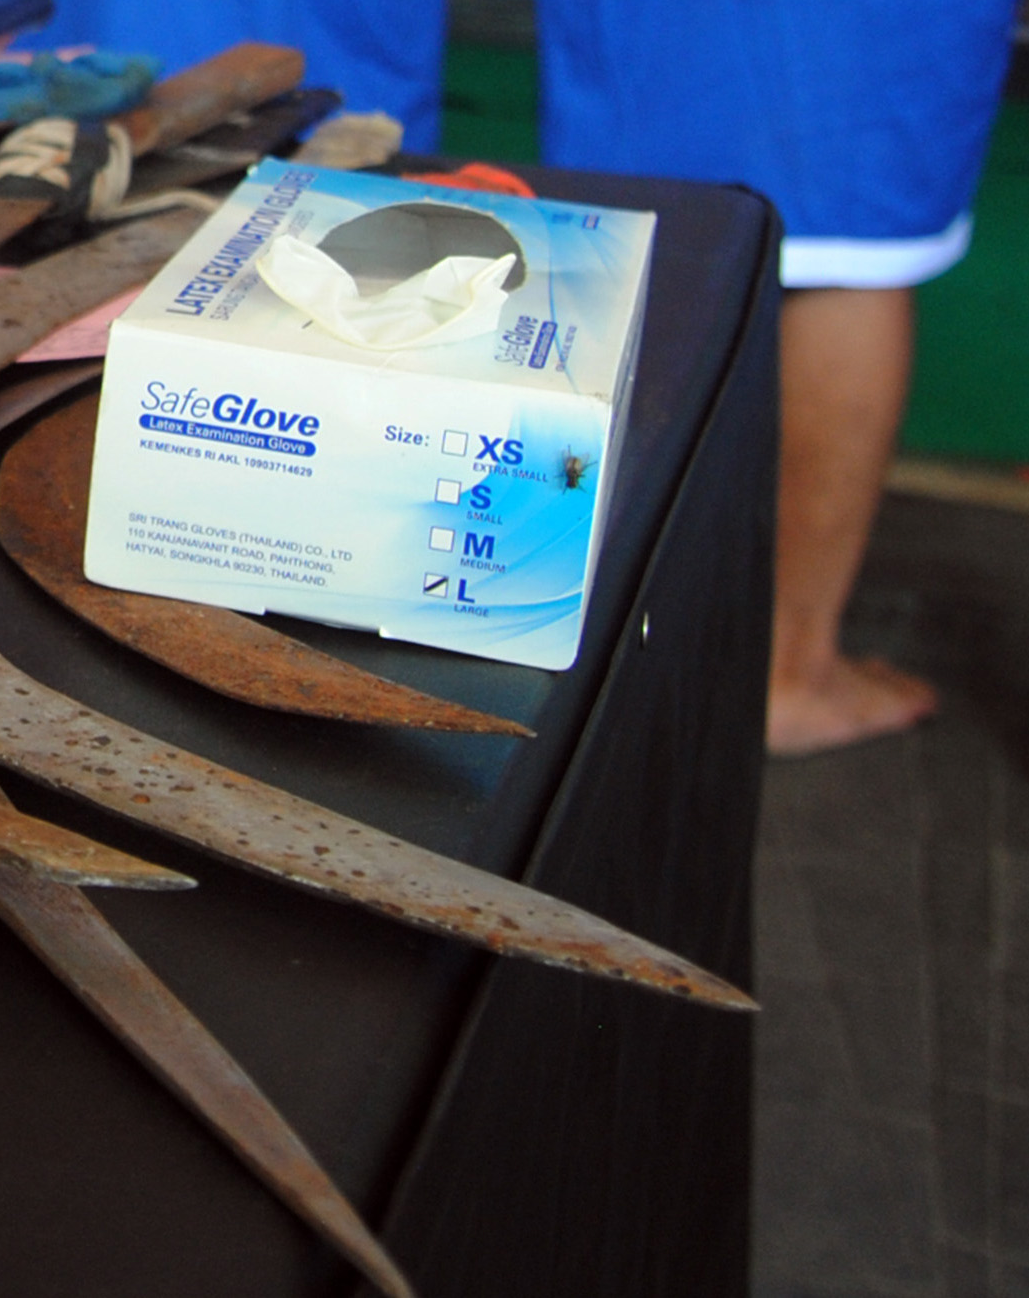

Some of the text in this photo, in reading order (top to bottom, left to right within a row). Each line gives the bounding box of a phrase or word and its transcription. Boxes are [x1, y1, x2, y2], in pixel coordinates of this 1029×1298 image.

[166, 276, 228, 316] LATEX
[201, 206, 288, 279] EXAMINATION
[140, 380, 321, 437] SafeGlove
[149, 416, 306, 454] Latex Examination Glove
[385, 425, 524, 466] Size: XS
[139, 439, 313, 478] KEMENKES RI AKL 10903714629
[472, 462, 549, 483] EXTRA SMALL
[469, 484, 492, 510] S
[466, 510, 504, 525] SMALL
[128, 512, 147, 524] SRI
[149, 516, 188, 533] TRANG
[191, 522, 236, 542] GLOVES
[239, 532, 303, 554] (THAILAND)
[331, 550, 353, 562] LTD
[128, 527, 145, 538] 110
[147, 530, 229, 554] KANJANAVANIT
[231, 546, 267, 562] ROAD,
[463, 532, 495, 560] M
[126, 541, 166, 558] HATYAI,
[169, 549, 231, 570] SONGKHLA
[460, 558, 506, 574] MEDIUM
[457, 578, 476, 604] L
[453, 604, 490, 618] LARGE
